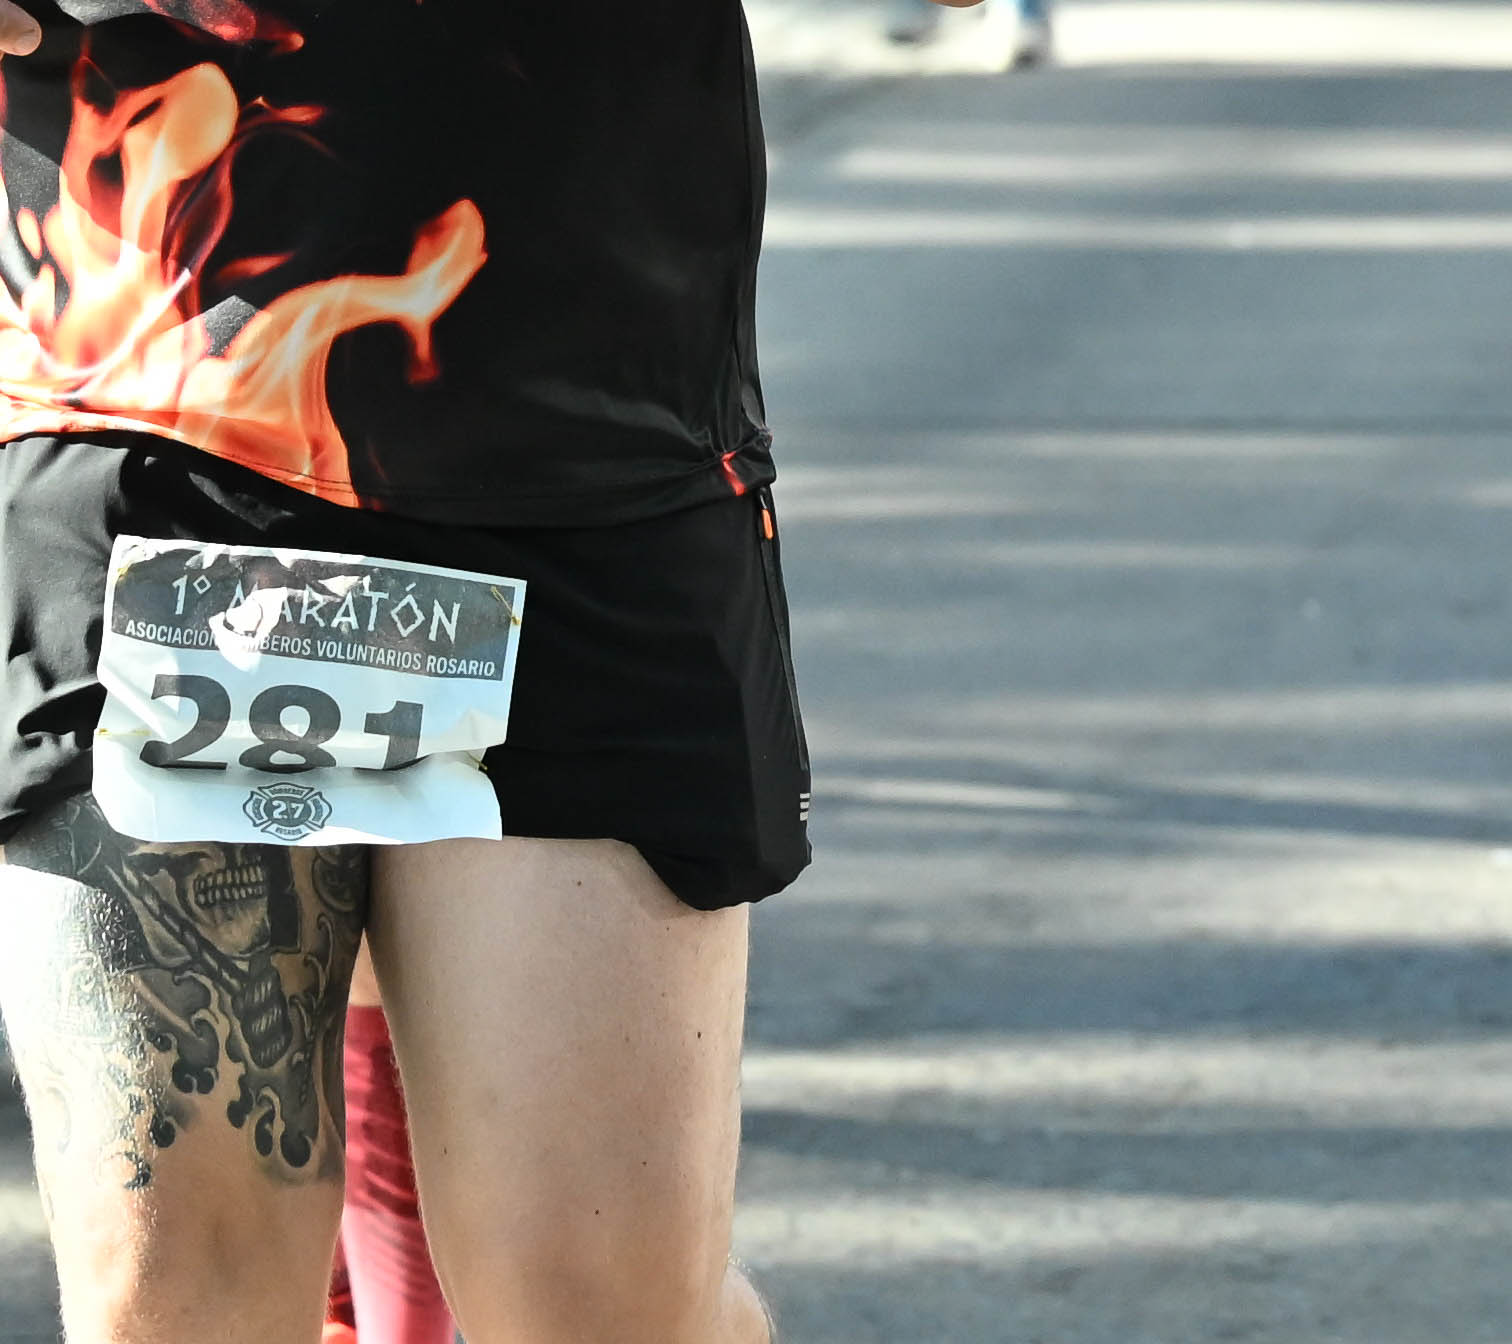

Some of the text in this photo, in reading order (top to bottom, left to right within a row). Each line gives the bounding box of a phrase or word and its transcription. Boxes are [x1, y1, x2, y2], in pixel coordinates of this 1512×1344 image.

[317, 639, 423, 672] VOLUNTARIOS
[426, 654, 496, 678] ROSARIO
[139, 672, 430, 774] 281
[271, 799, 305, 819] 27
